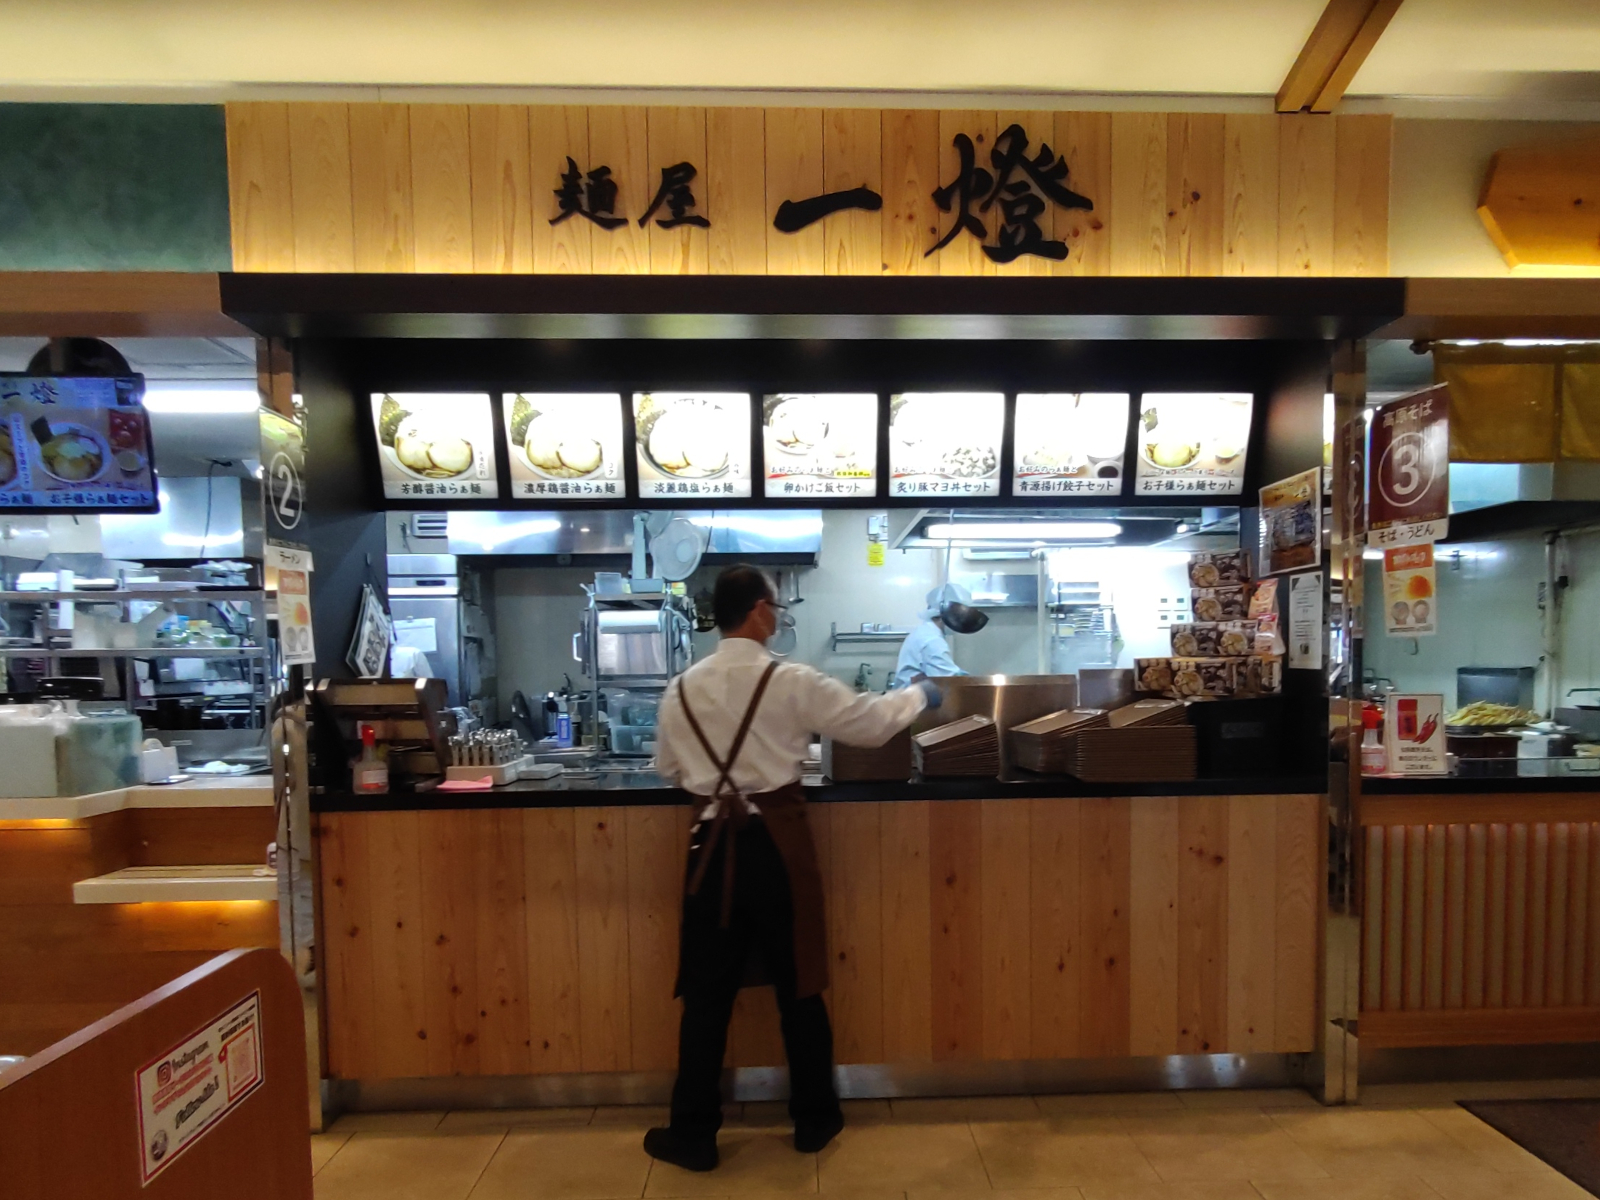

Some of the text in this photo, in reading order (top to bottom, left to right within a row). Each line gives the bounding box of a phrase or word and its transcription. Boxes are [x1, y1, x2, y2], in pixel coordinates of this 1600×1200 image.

[549, 156, 710, 231] 麺屋
[1382, 399, 1433, 429] 高原そば
[278, 464, 295, 517] 2
[401, 482, 482, 495] 芳醇醤油らぁ麺
[523, 482, 616, 495] 濃厚鶏醤油らぁ麺
[654, 482, 734, 494] 淡麗鶏塩らぁ麺
[784, 482, 861, 494] 卵かけご飯セット
[896, 481, 991, 494] 炙り豚マヨ丼セット
[1019, 481, 1114, 492] 青源揚げ餃子セット
[1142, 480, 1235, 491] お子様らぁ麺セット
[1378, 524, 1436, 544] そば・うどん
